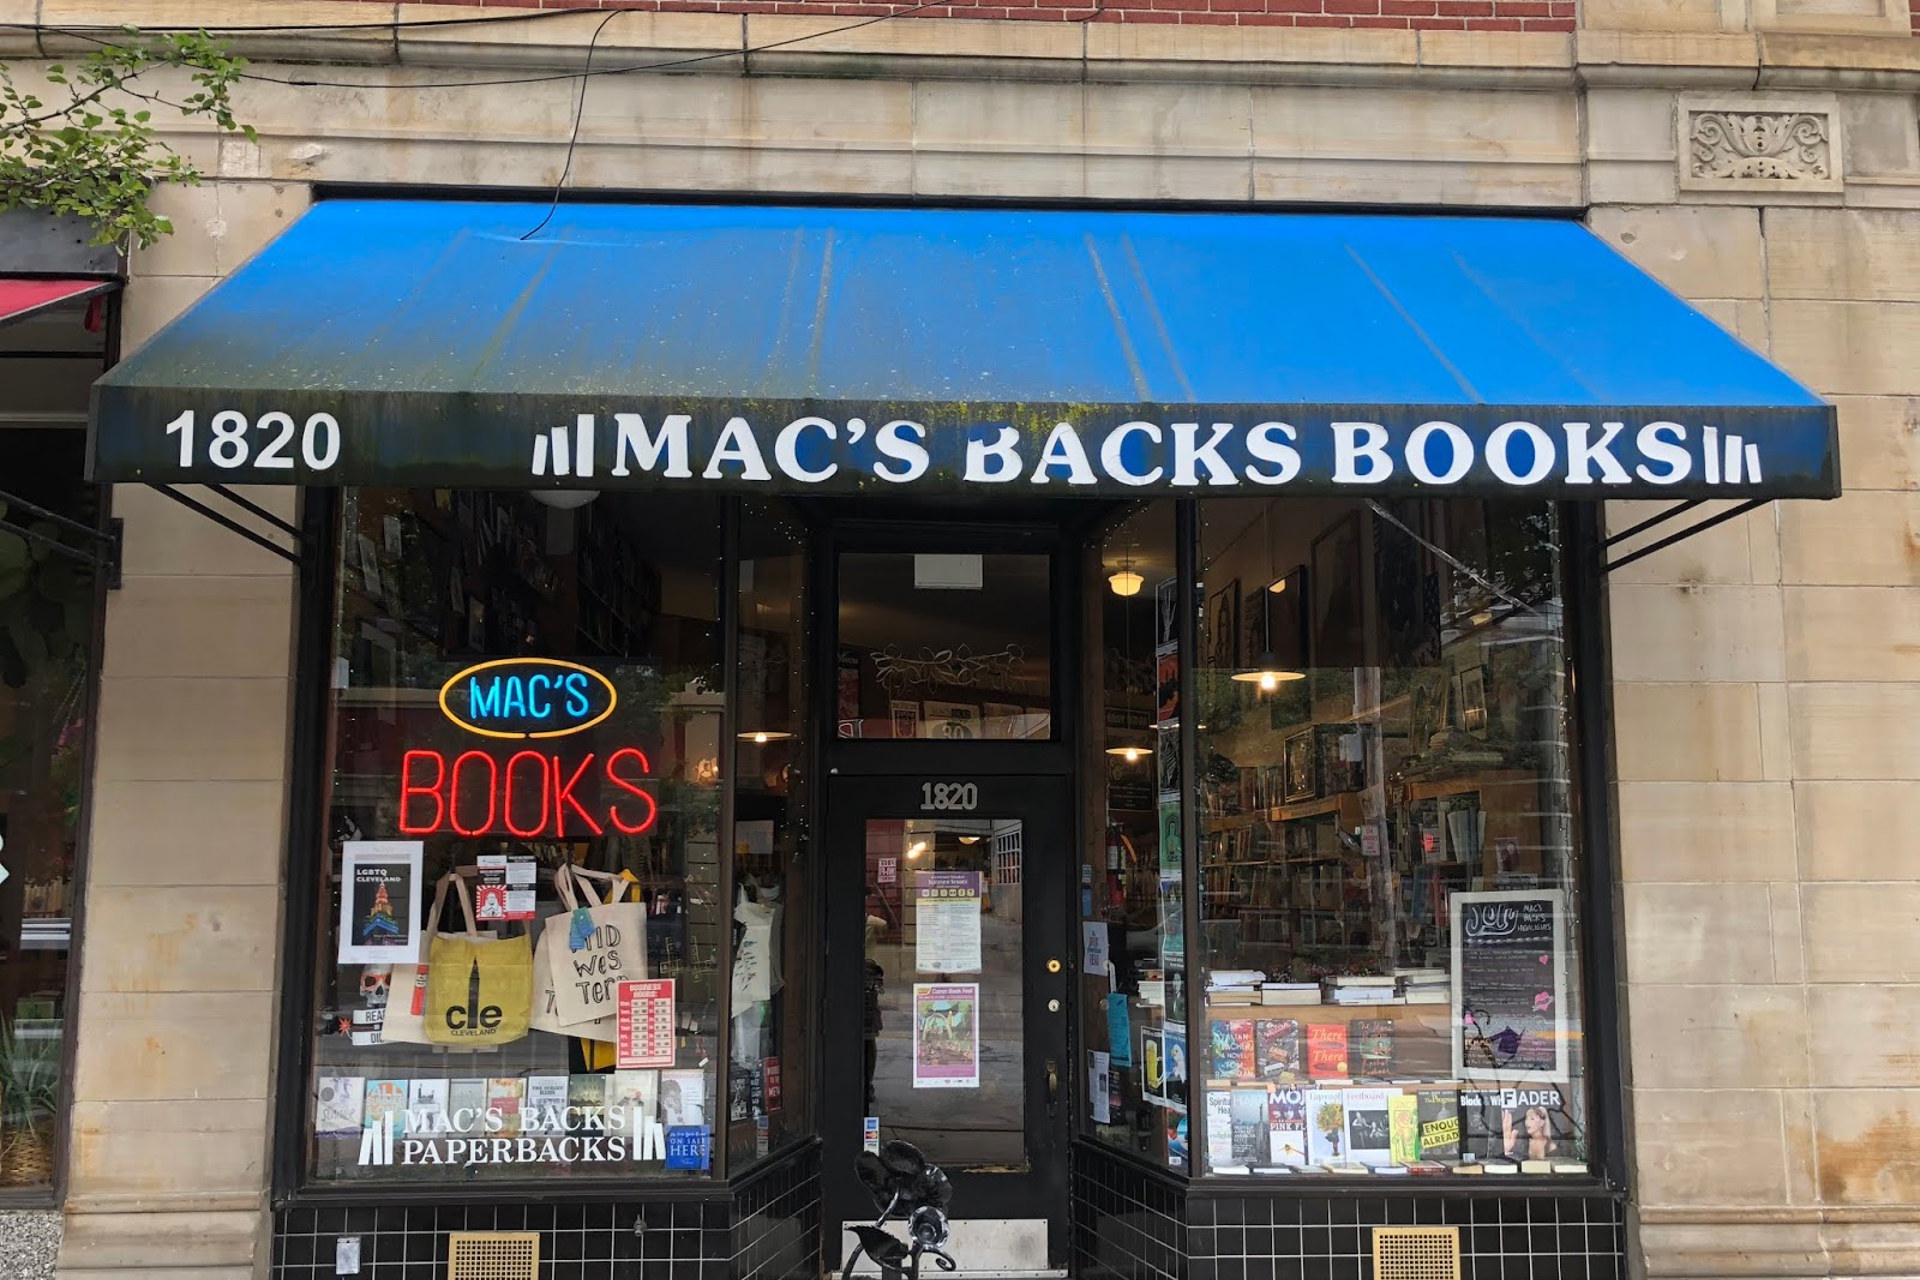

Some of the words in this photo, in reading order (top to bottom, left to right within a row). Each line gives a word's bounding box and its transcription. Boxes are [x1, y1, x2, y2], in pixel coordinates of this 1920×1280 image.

[165, 409, 341, 471] 1820
[611, 413, 930, 483] MAC'S
[963, 421, 1302, 486] BACKS
[1331, 421, 1693, 485] BOOKS
[468, 672, 590, 719] MAC'S
[399, 747, 657, 838] BOOKS
[920, 782, 978, 810] 1820
[451, 1028, 497, 1036] CLEVELAND
[1312, 1029, 1343, 1041] There
[1312, 1050, 1344, 1062] There
[1504, 1090, 1561, 1108] FADER
[402, 1107, 503, 1134] MAC'S
[519, 1105, 626, 1132] BACKS
[402, 1136, 626, 1165] PAPERBACKS
[670, 1145, 706, 1156] HERE
